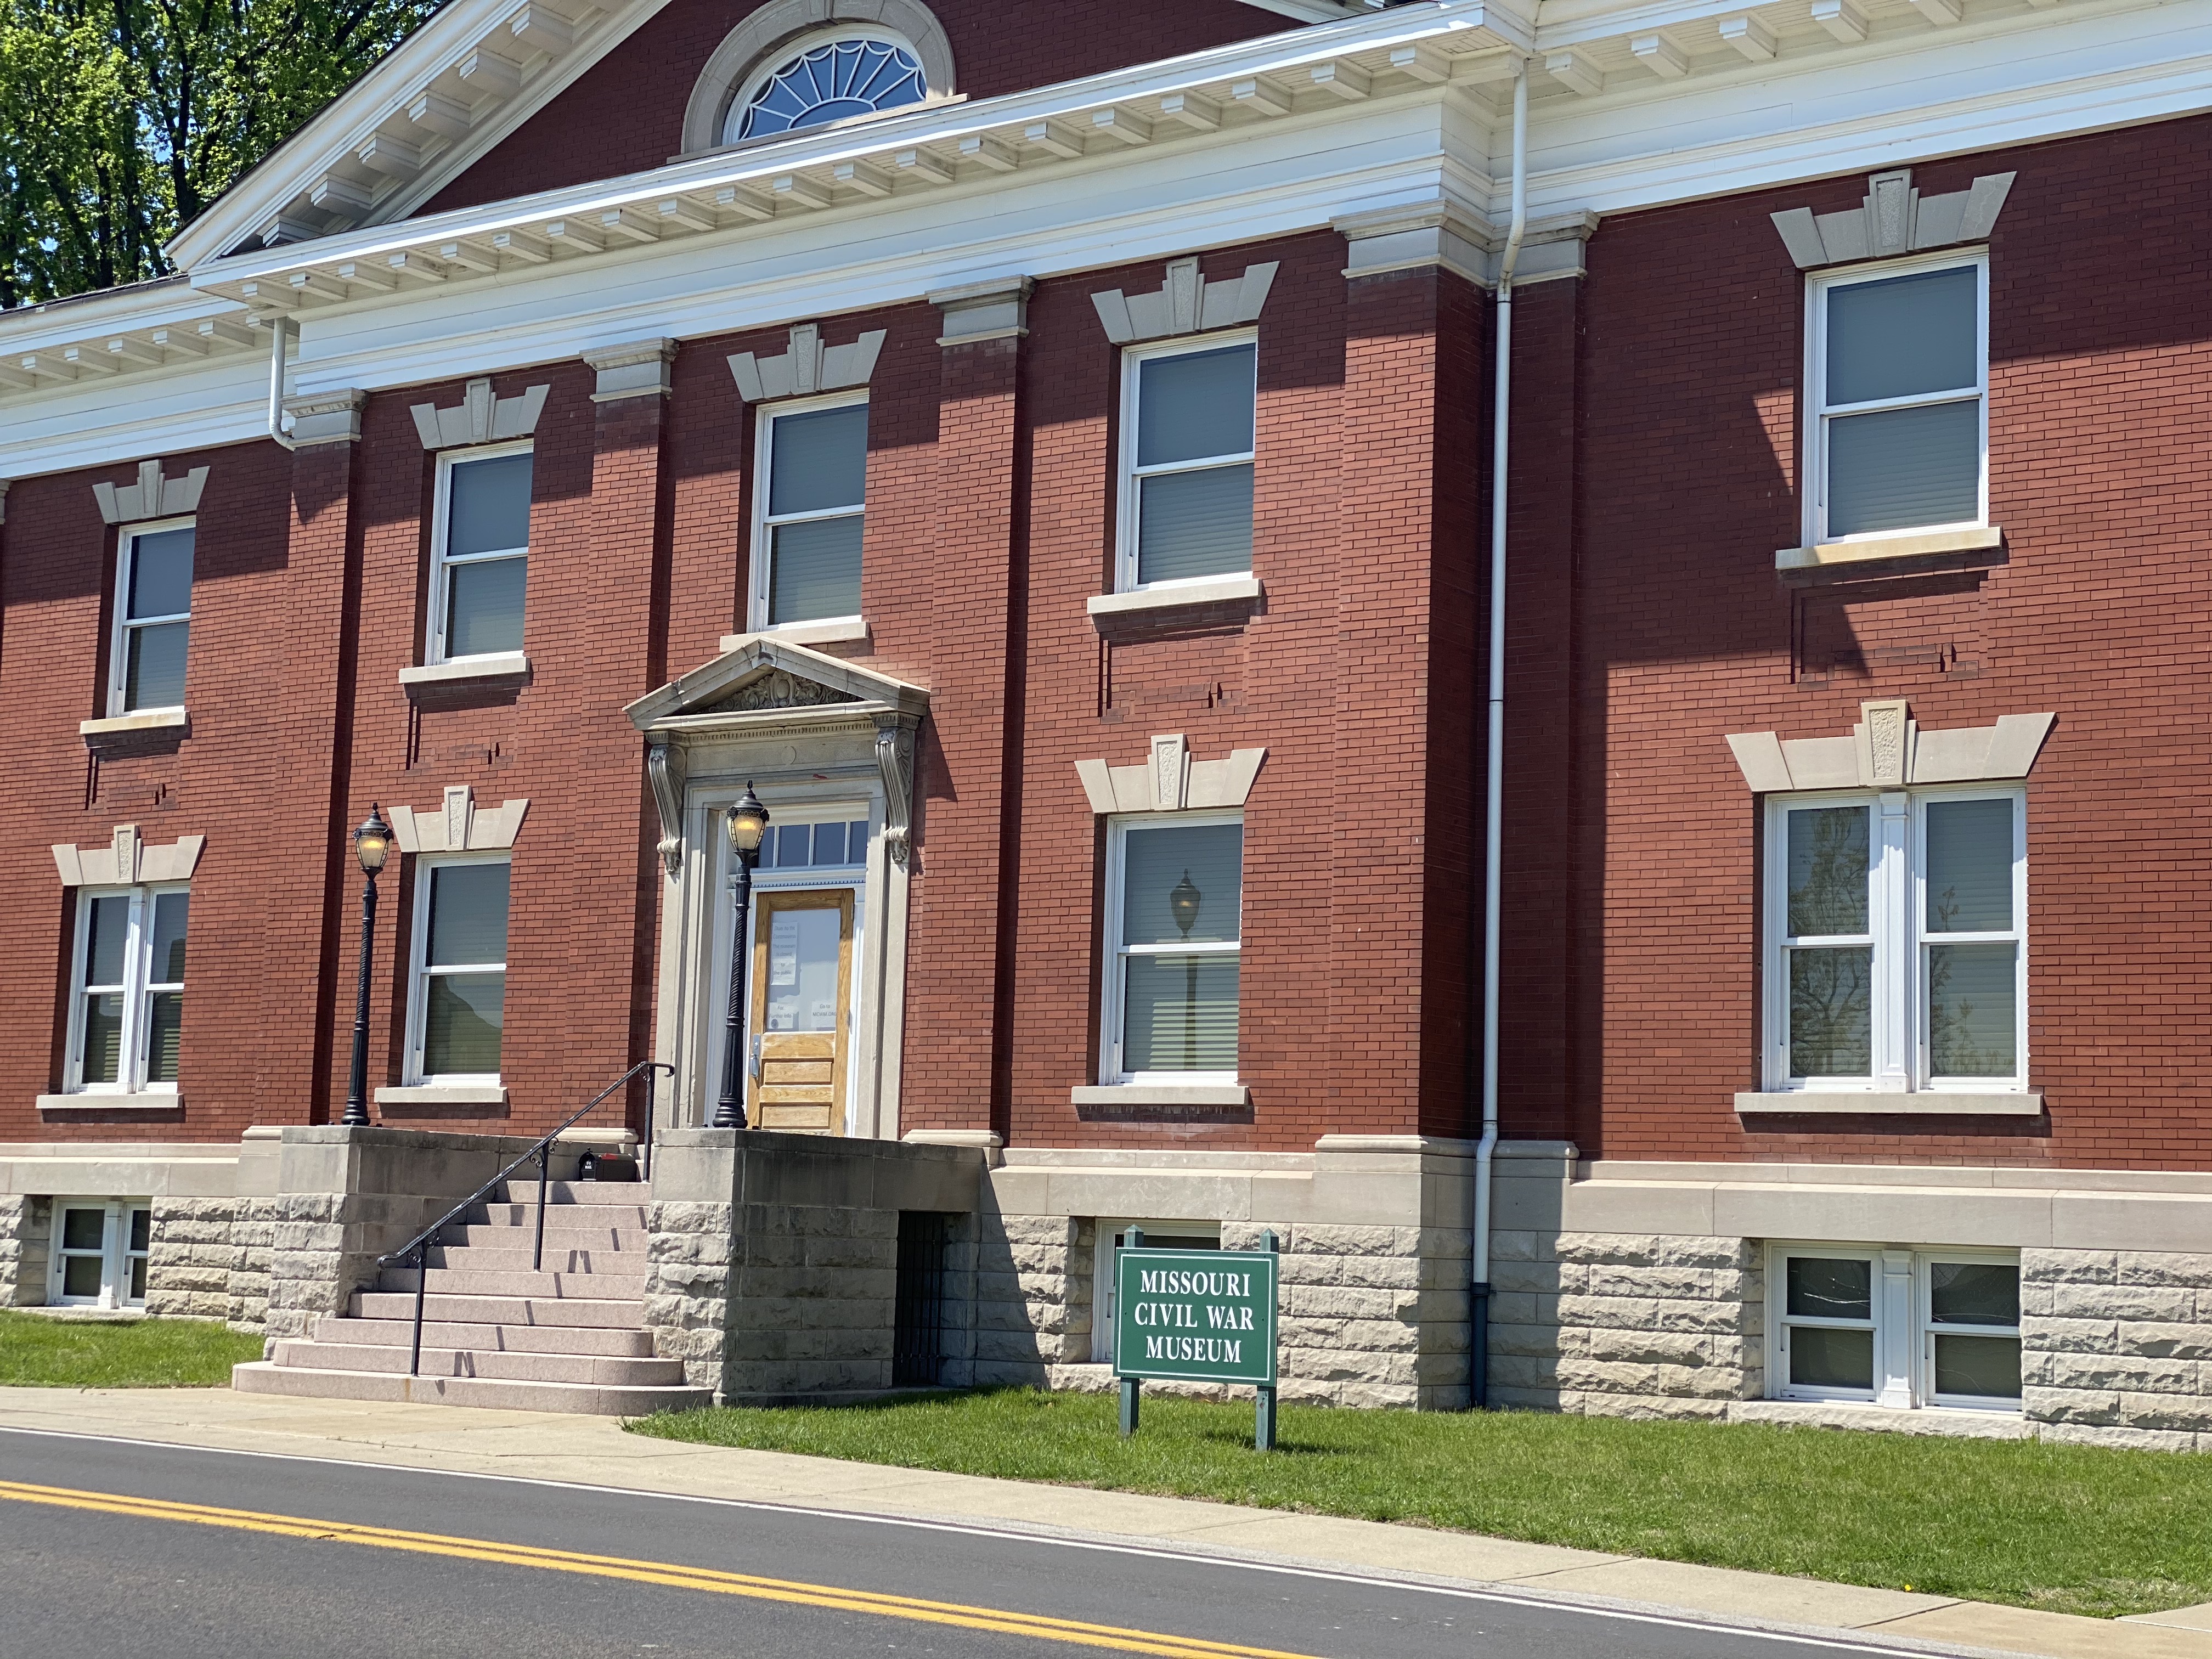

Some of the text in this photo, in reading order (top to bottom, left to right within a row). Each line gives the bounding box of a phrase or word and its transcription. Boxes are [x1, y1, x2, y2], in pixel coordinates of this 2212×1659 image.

[1140, 1270, 1250, 1296] MISSOURI
[1135, 1302, 1254, 1330] CIVIL WAR
[1146, 1336, 1241, 1363] MUSEUM
